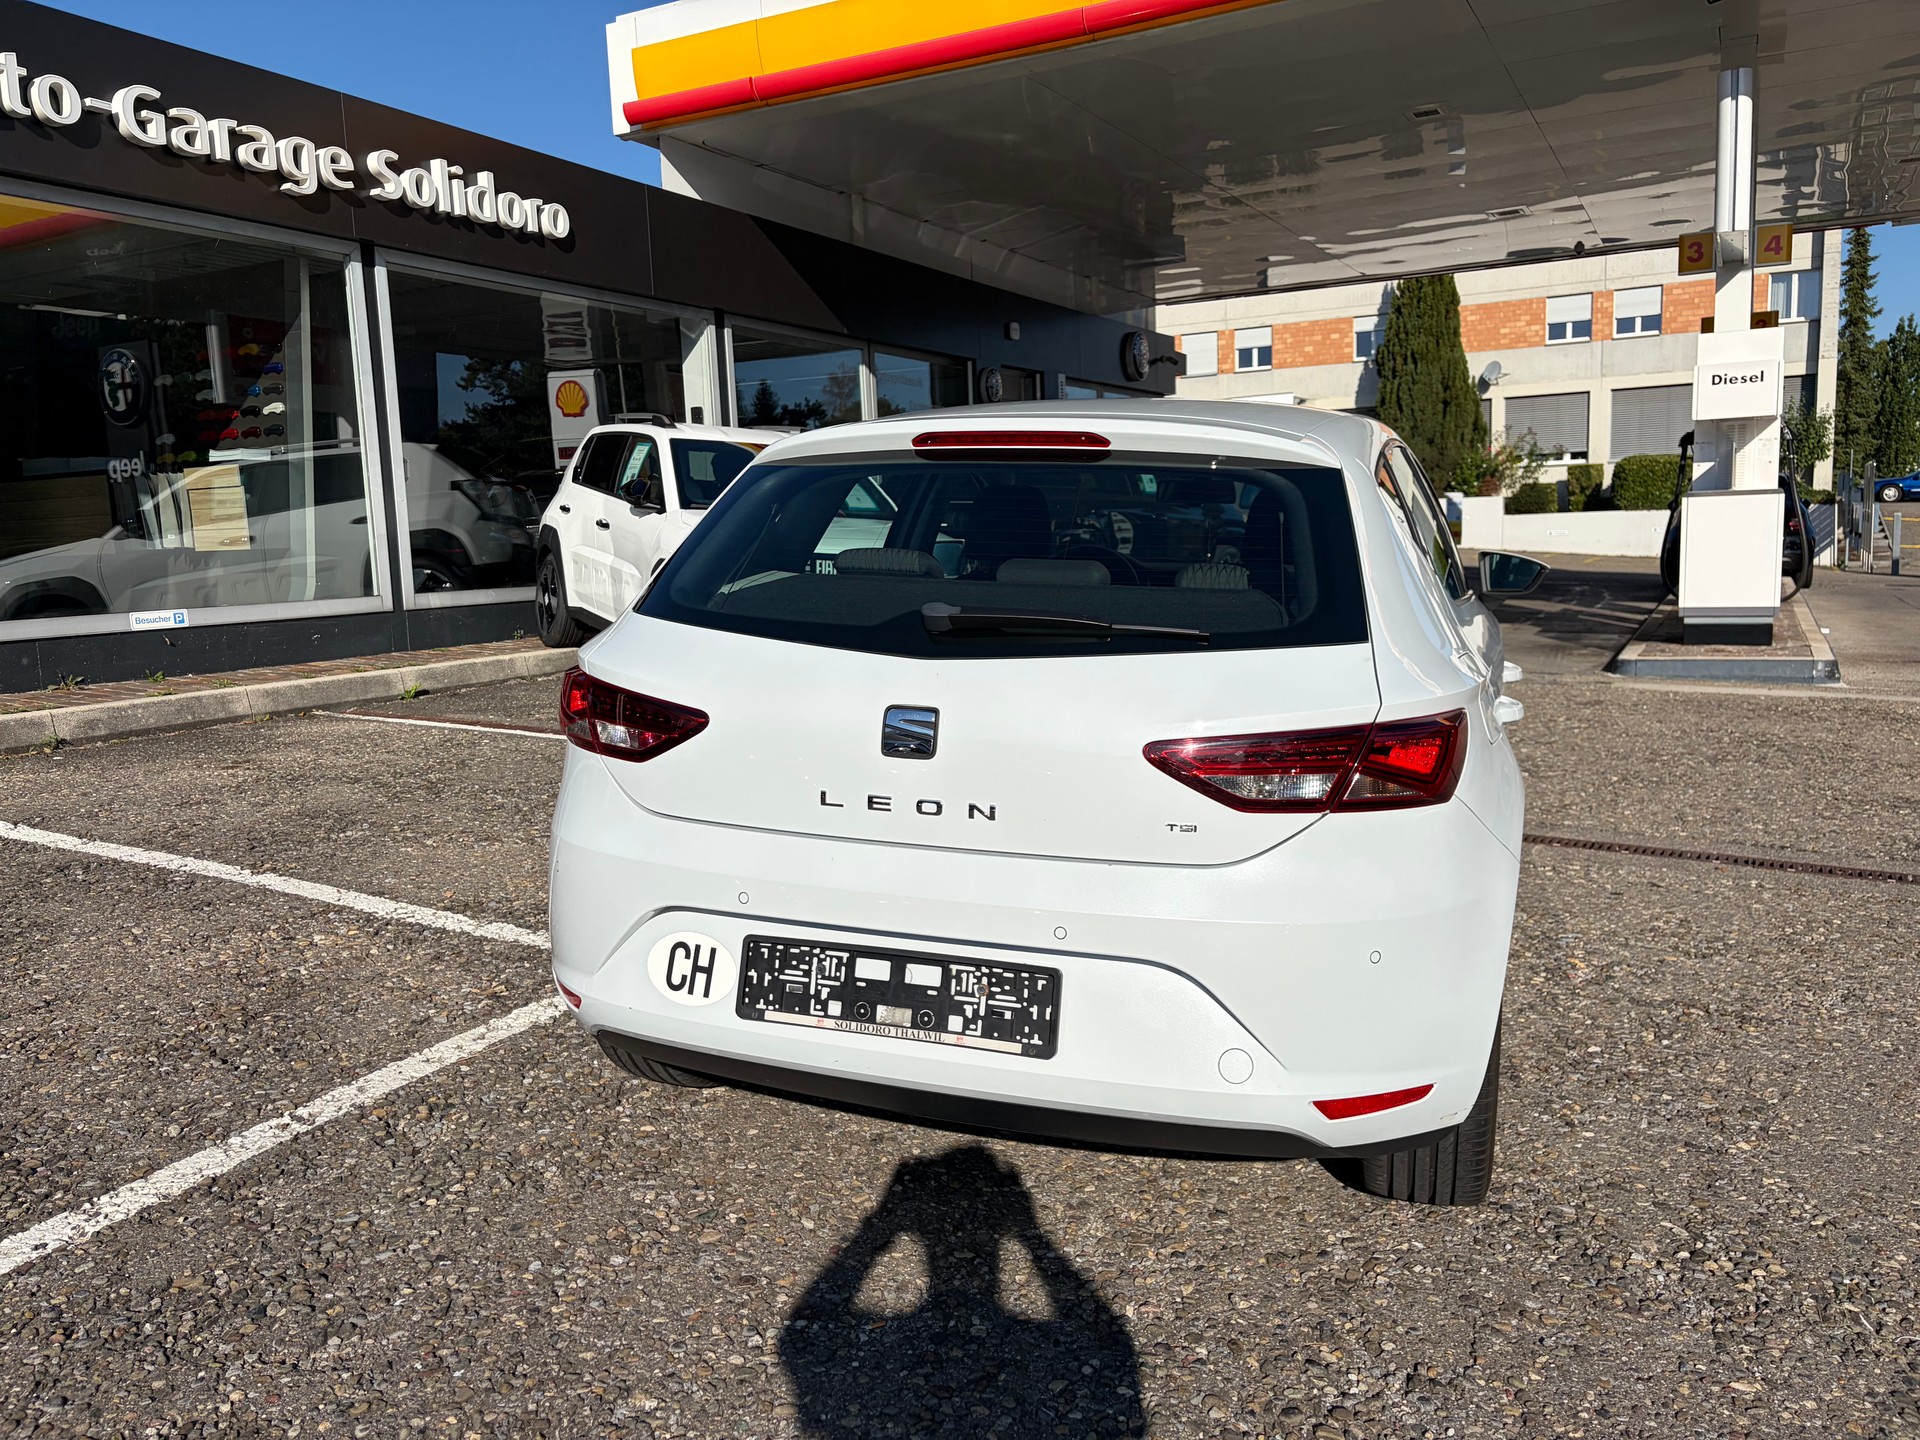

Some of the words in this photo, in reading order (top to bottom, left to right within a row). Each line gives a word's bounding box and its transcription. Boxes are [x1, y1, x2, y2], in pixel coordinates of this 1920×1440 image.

[366, 149, 571, 239] Solidoro
[1686, 241, 1704, 263] 3
[1764, 234, 1783, 255] 4
[1711, 370, 1764, 386] Diesel
[134, 616, 172, 625] Besucher
[820, 789, 997, 821] LEON
[1165, 823, 1198, 833] TSI
[665, 940, 718, 999] CH
[832, 1020, 892, 1036] SOLIDORO
[893, 1027, 946, 1043] THALWIL
